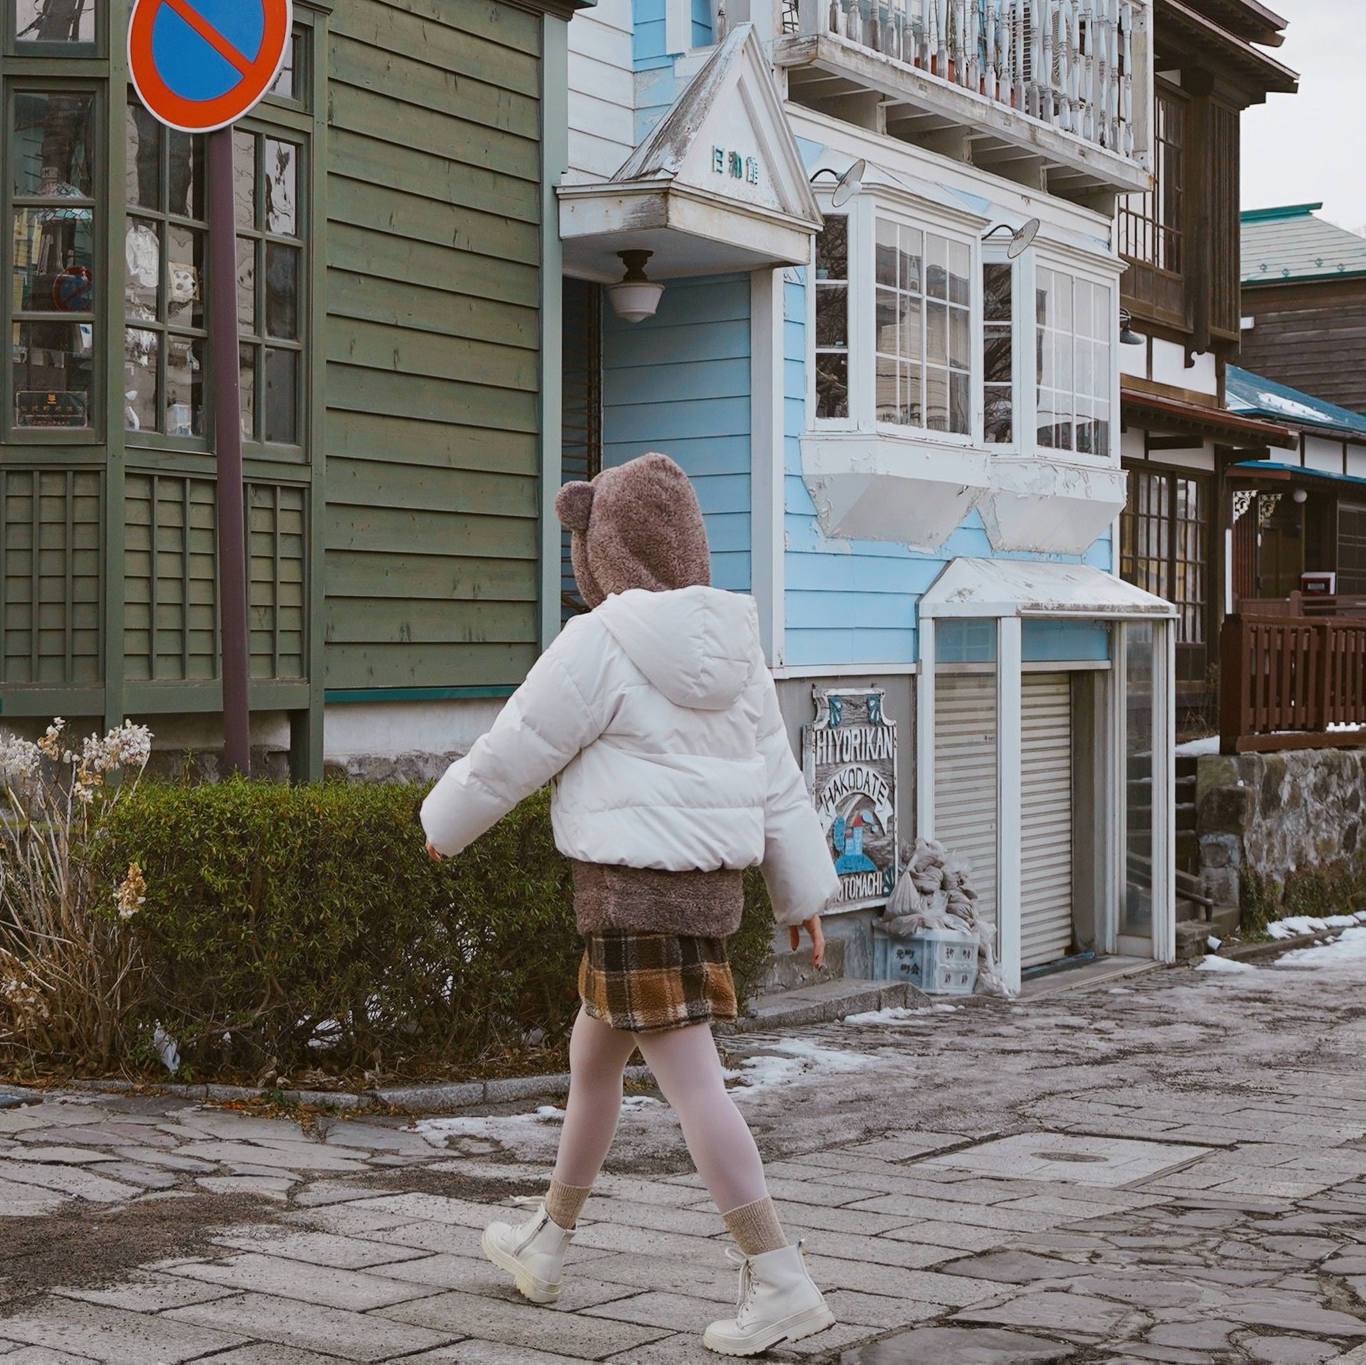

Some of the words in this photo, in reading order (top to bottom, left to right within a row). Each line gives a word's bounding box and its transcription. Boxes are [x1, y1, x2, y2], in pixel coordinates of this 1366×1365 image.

[816, 726, 893, 765] HIYORIKAN
[820, 767, 887, 813] HAKODATE
[837, 871, 883, 902] OTOMACHI
